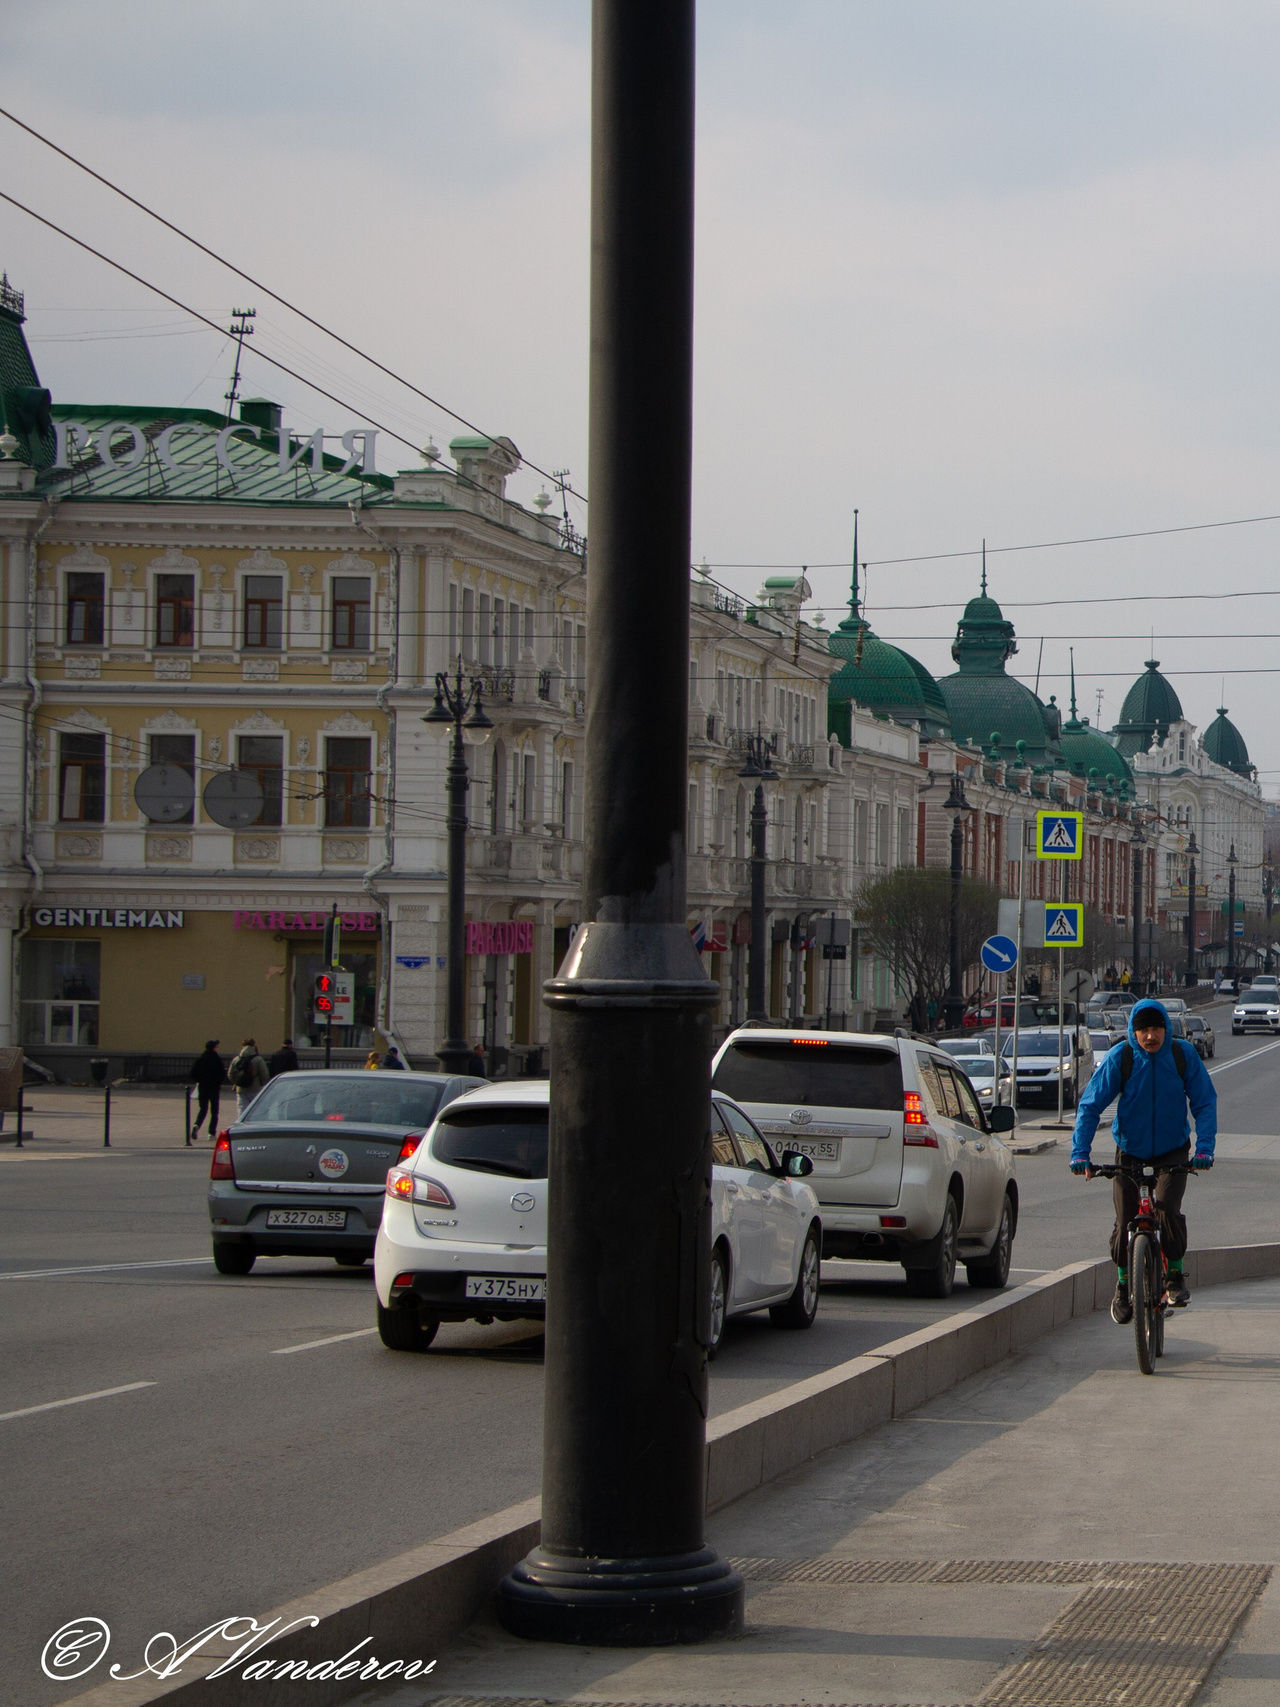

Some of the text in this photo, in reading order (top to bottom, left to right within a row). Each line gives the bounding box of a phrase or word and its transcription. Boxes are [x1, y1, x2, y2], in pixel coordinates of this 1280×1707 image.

[53, 422, 380, 475] РОССИЯ
[35, 909, 184, 927] GENTLEMAN
[234, 911, 377, 931] PARADSE
[467, 921, 534, 954] PARADISE
[337, 986, 348, 995] LE
[317, 997, 331, 1010] 95
[818, 1127, 850, 1135] PRADO
[771, 1141, 833, 1156] 010ЕХ 55
[328, 1213, 341, 1222] 55
[473, 1280, 539, 1297] У375НУ
